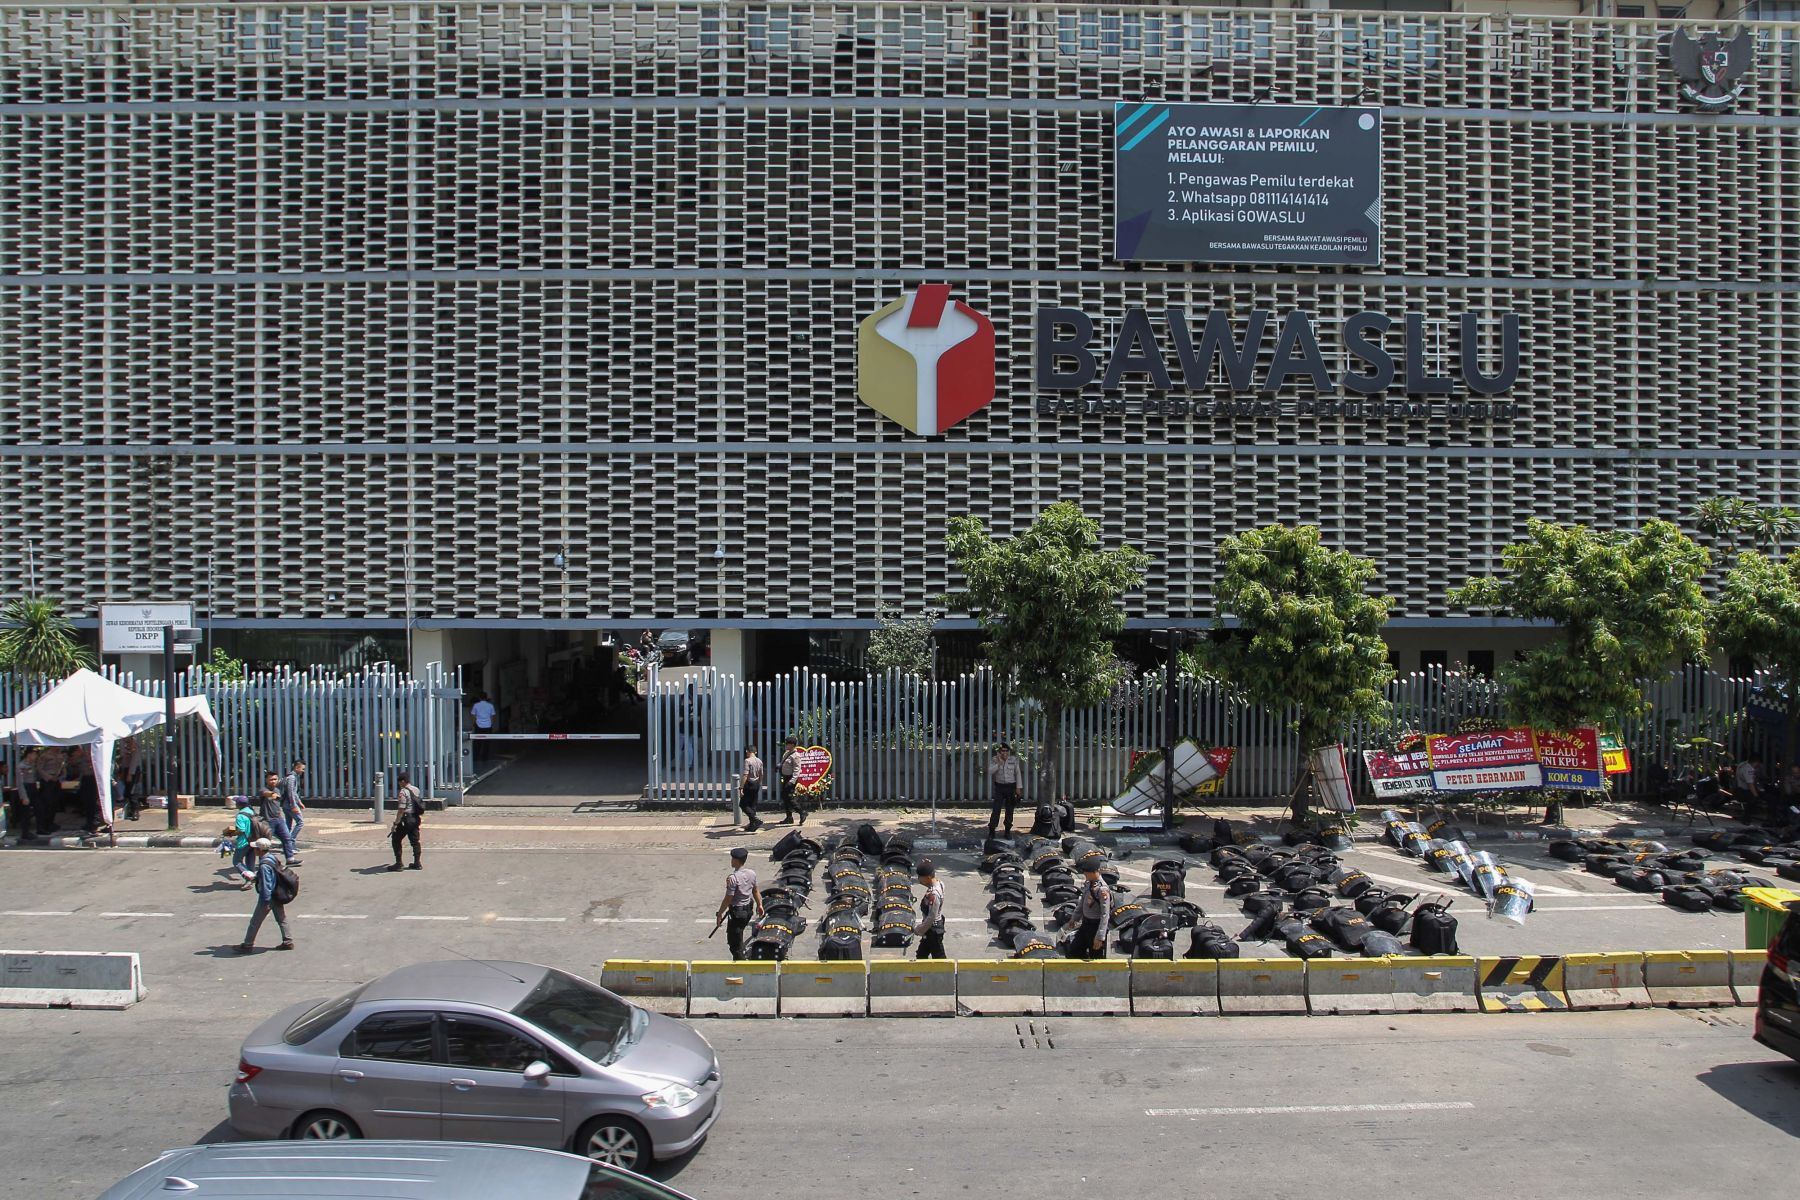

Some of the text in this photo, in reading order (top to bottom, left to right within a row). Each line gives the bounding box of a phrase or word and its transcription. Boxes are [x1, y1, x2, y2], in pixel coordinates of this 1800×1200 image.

[1168, 126, 1330, 139] AYO AWASI & LAPORKAN
[1168, 139, 1318, 153] PELANGGARAN PEMILU,
[1168, 152, 1225, 164] MELALUI:
[1168, 172, 1354, 188] 1. Pengawas Pemilu terdekat
[1168, 190, 1329, 207] 2. Whatsapp 081114141414
[1168, 208, 1306, 224] 3. Aplikasi GOWASLU
[1263, 234, 1296, 242] BERSAMA
[1242, 242, 1274, 250] BAWASLU
[1343, 244, 1368, 252] PEMILU
[1036, 307, 1520, 395] BAWASLU
[1036, 398, 1519, 419] BADAN PENGAWAS PEMILIHAN UMUM
[135, 632, 159, 640] DKPP
[1459, 739, 1503, 753] SELAMAT
[1559, 757, 1579, 767] KPU
[1446, 771, 1526, 785] PETER HERRMANN
[1548, 772, 1583, 784] KOM'88
[762, 924, 793, 935] POLISI
[881, 923, 912, 932] POLISI
